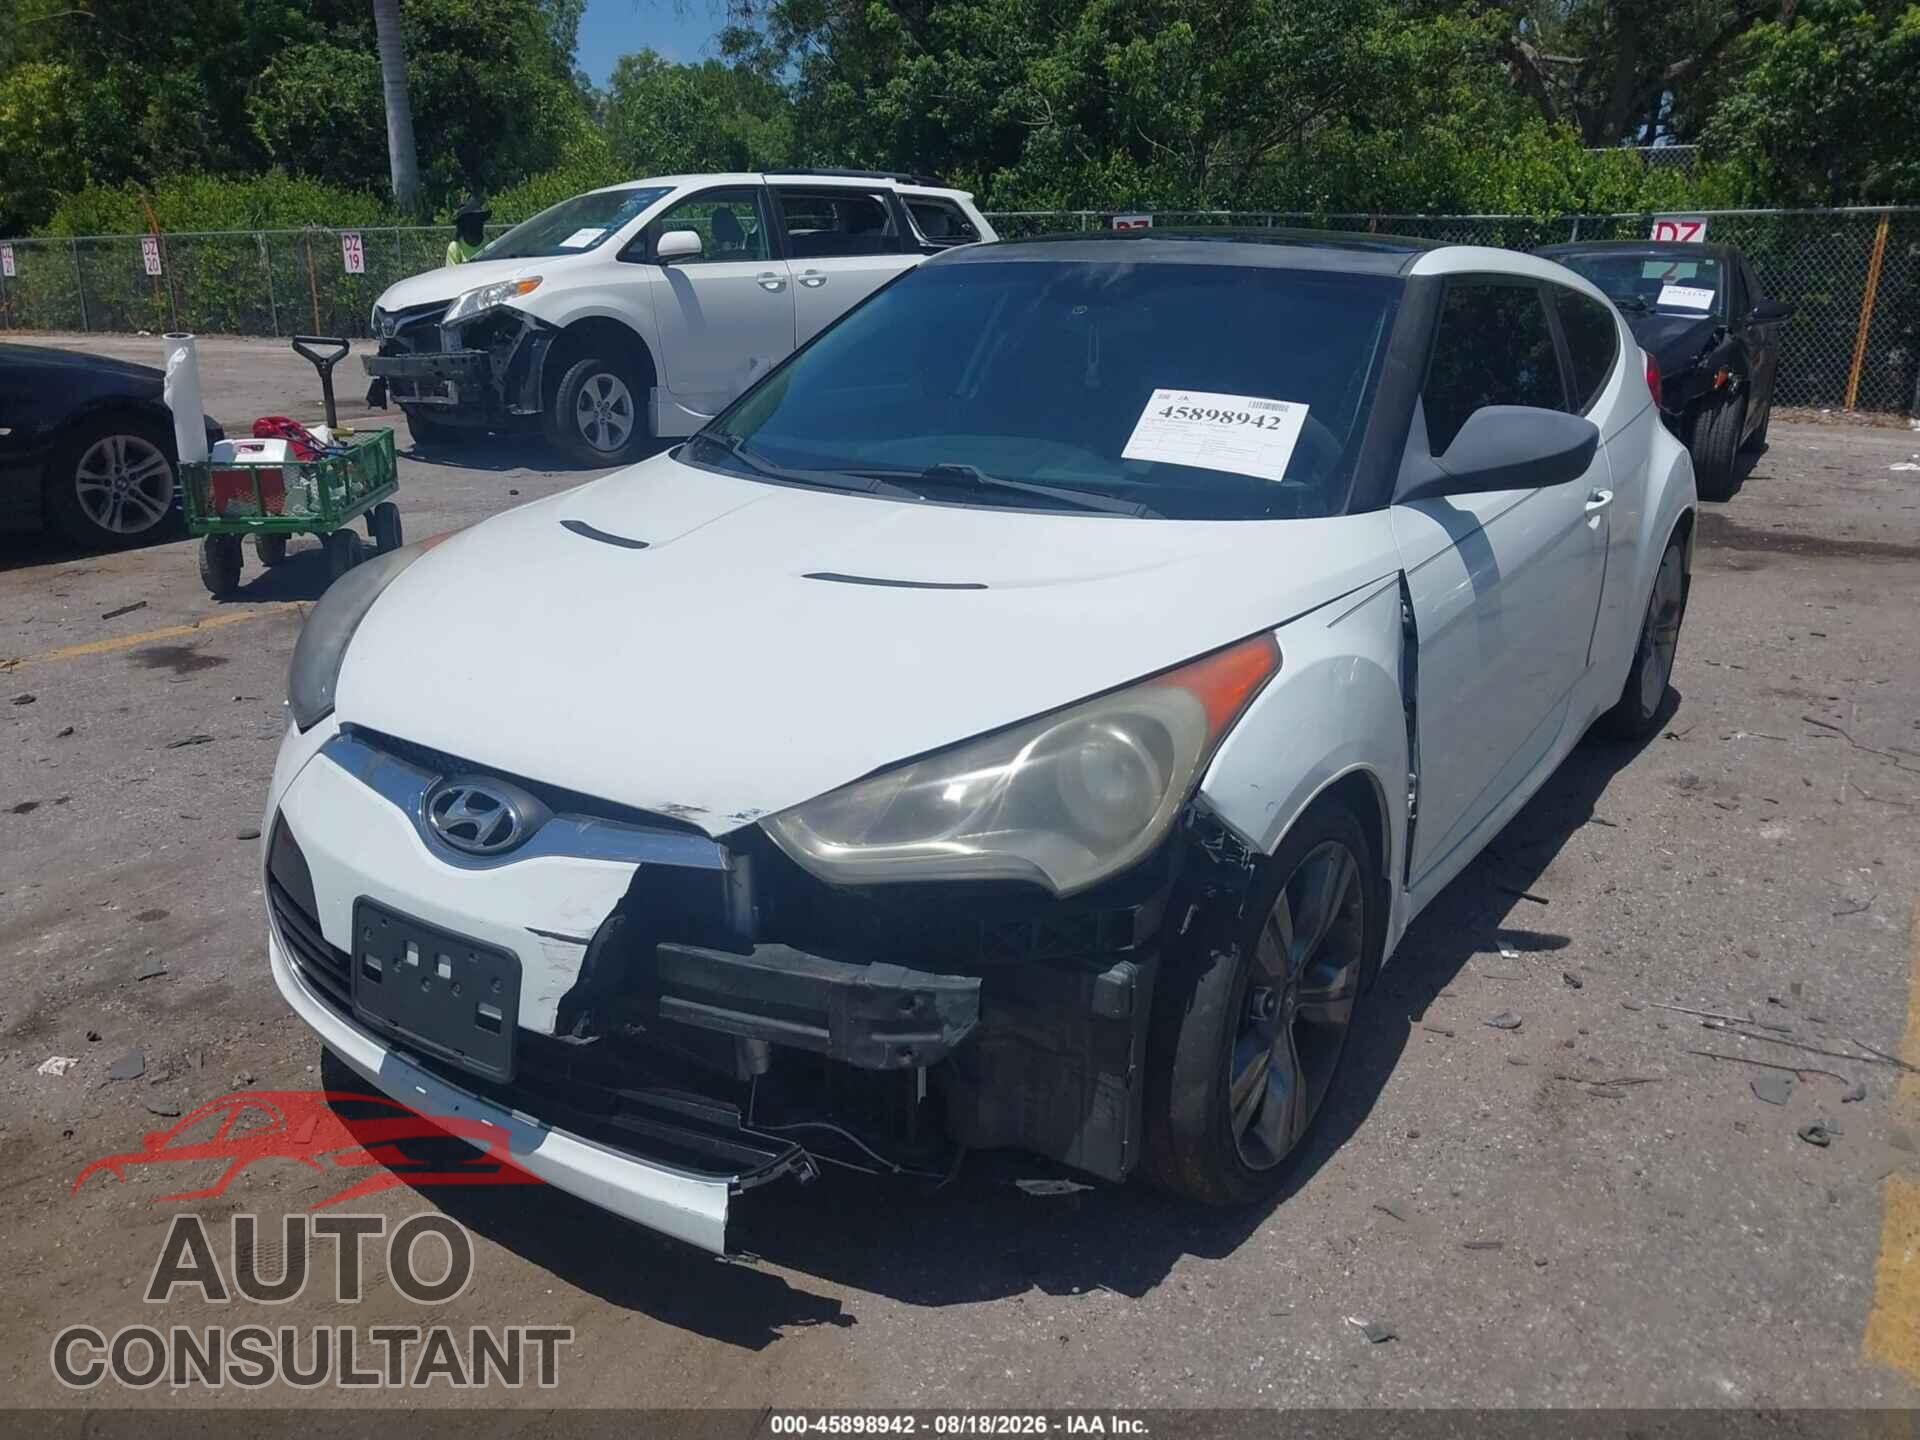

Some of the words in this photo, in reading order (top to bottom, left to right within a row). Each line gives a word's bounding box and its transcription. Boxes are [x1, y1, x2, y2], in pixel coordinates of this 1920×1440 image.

[1655, 221, 1701, 242] DZ
[143, 240, 157, 255] DZ
[343, 234, 361, 251] DZ
[146, 257, 159, 272] 20
[348, 253, 360, 270] 19
[1158, 405, 1281, 431] 45898942
